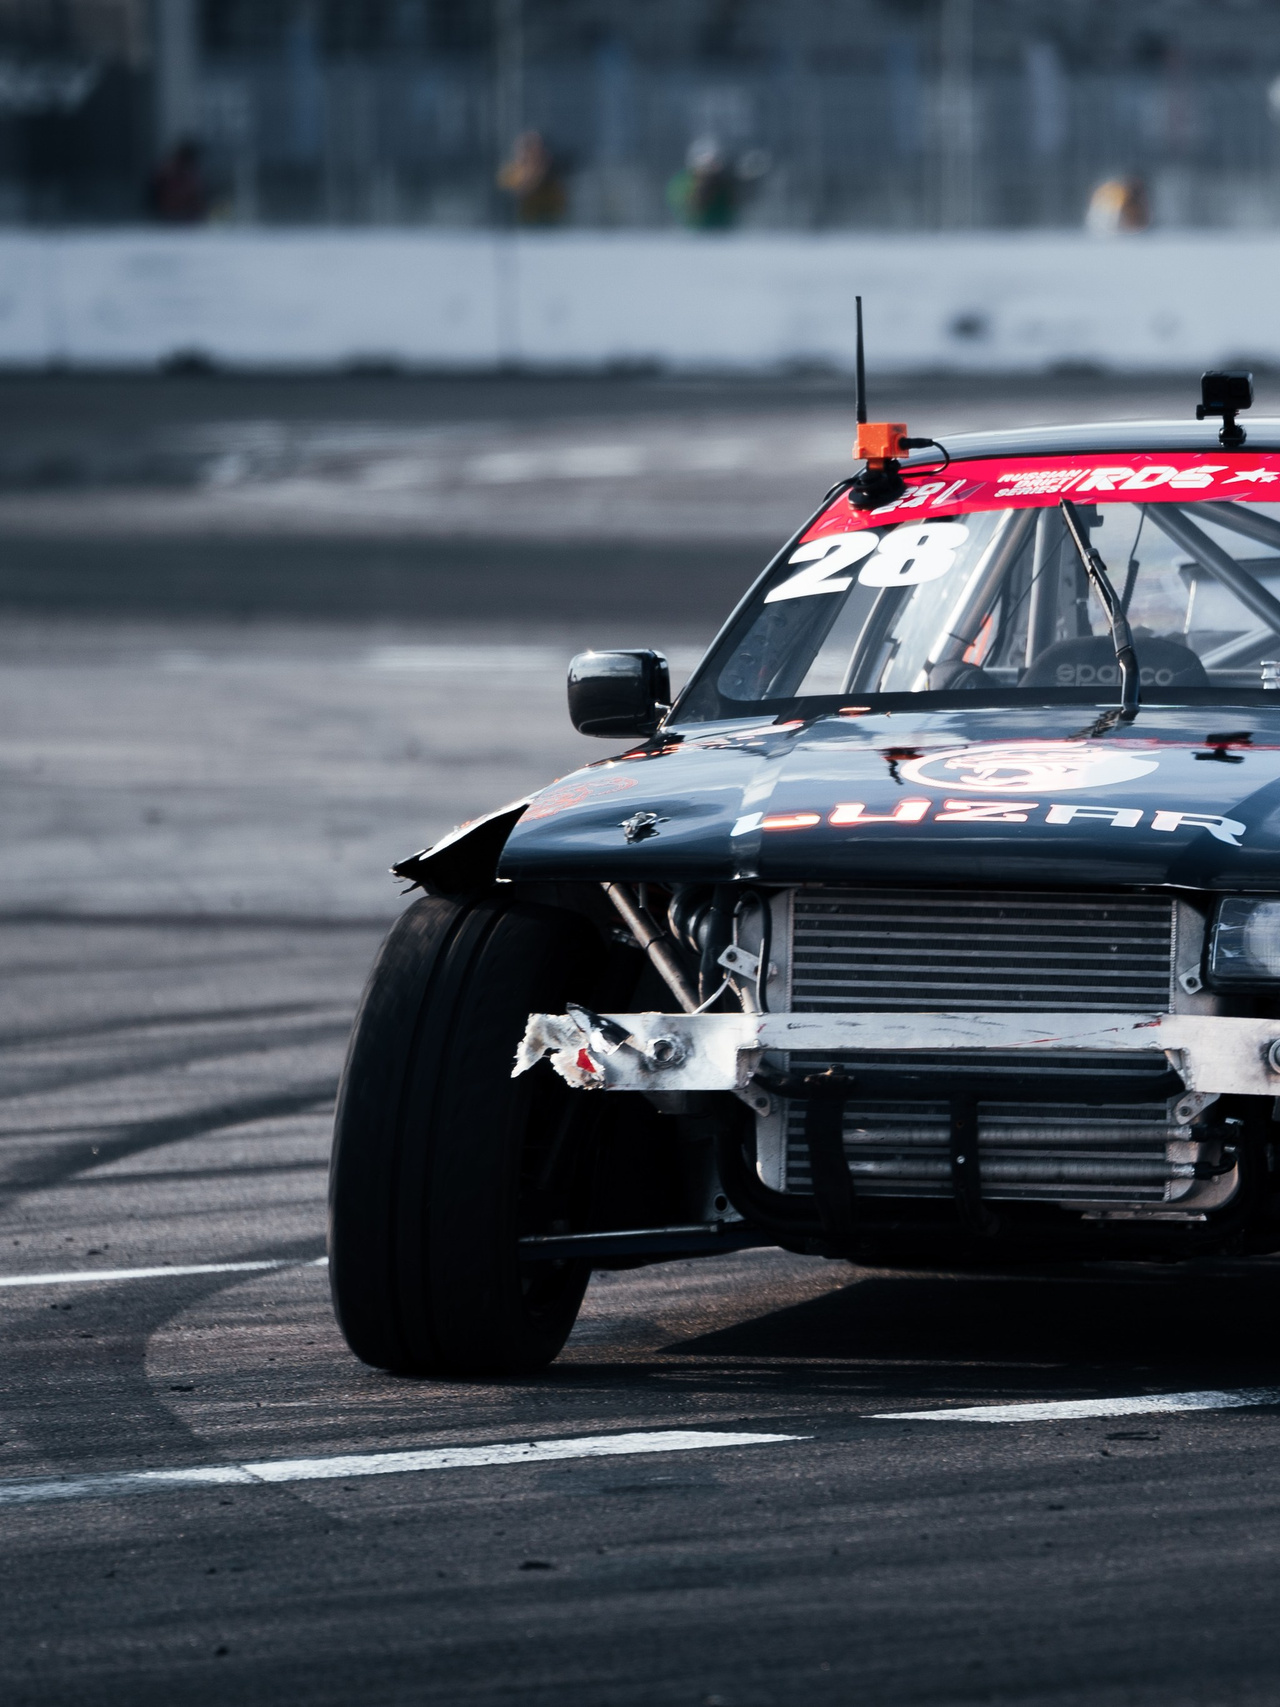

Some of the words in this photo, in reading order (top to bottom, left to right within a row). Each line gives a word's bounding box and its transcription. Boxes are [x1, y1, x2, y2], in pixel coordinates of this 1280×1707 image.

[997, 469, 1082, 483] RUSSIAN
[1013, 477, 1074, 488] DRIFT
[1075, 466, 1229, 492] RDS
[994, 485, 1062, 497] SERIES
[764, 522, 970, 604] 28
[1056, 663, 1174, 686] spaco
[730, 797, 1247, 847] LUZAR
